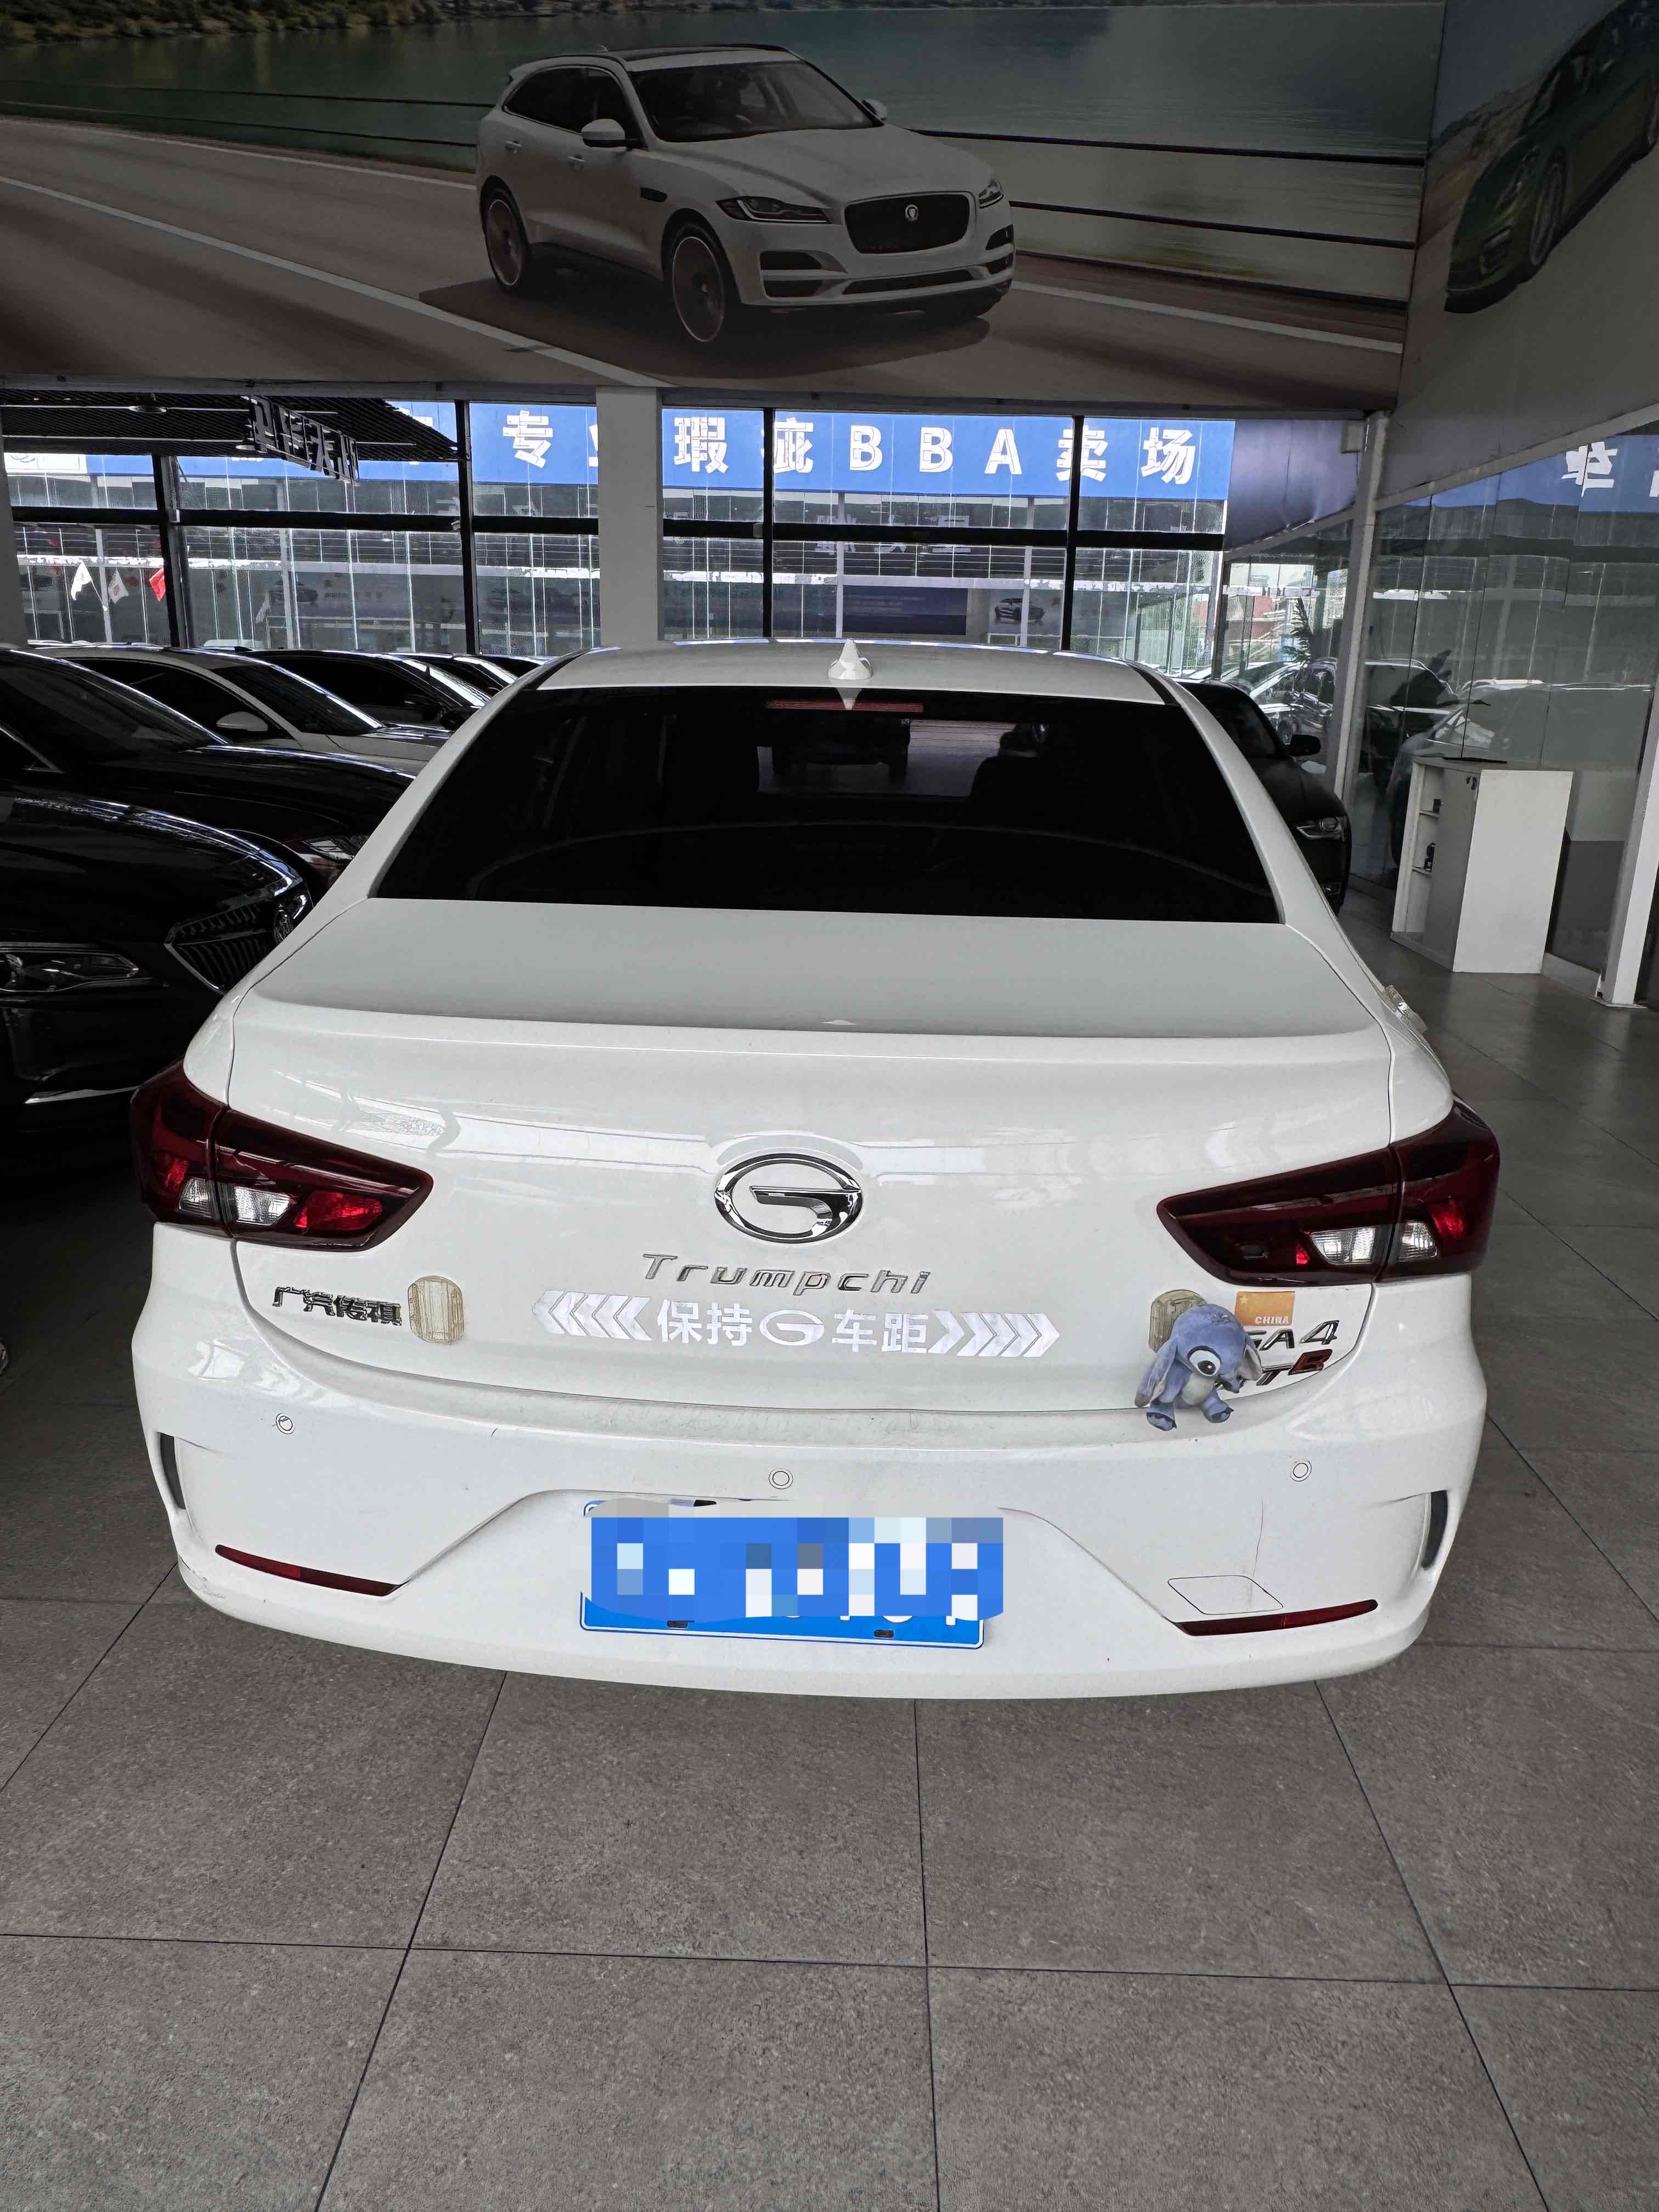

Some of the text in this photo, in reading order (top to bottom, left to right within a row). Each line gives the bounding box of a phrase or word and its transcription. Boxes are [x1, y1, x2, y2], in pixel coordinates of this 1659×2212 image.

[502, 410, 1196, 485] 专瑕疵BBA卖场
[642, 1252, 932, 1296] Trumpchi
